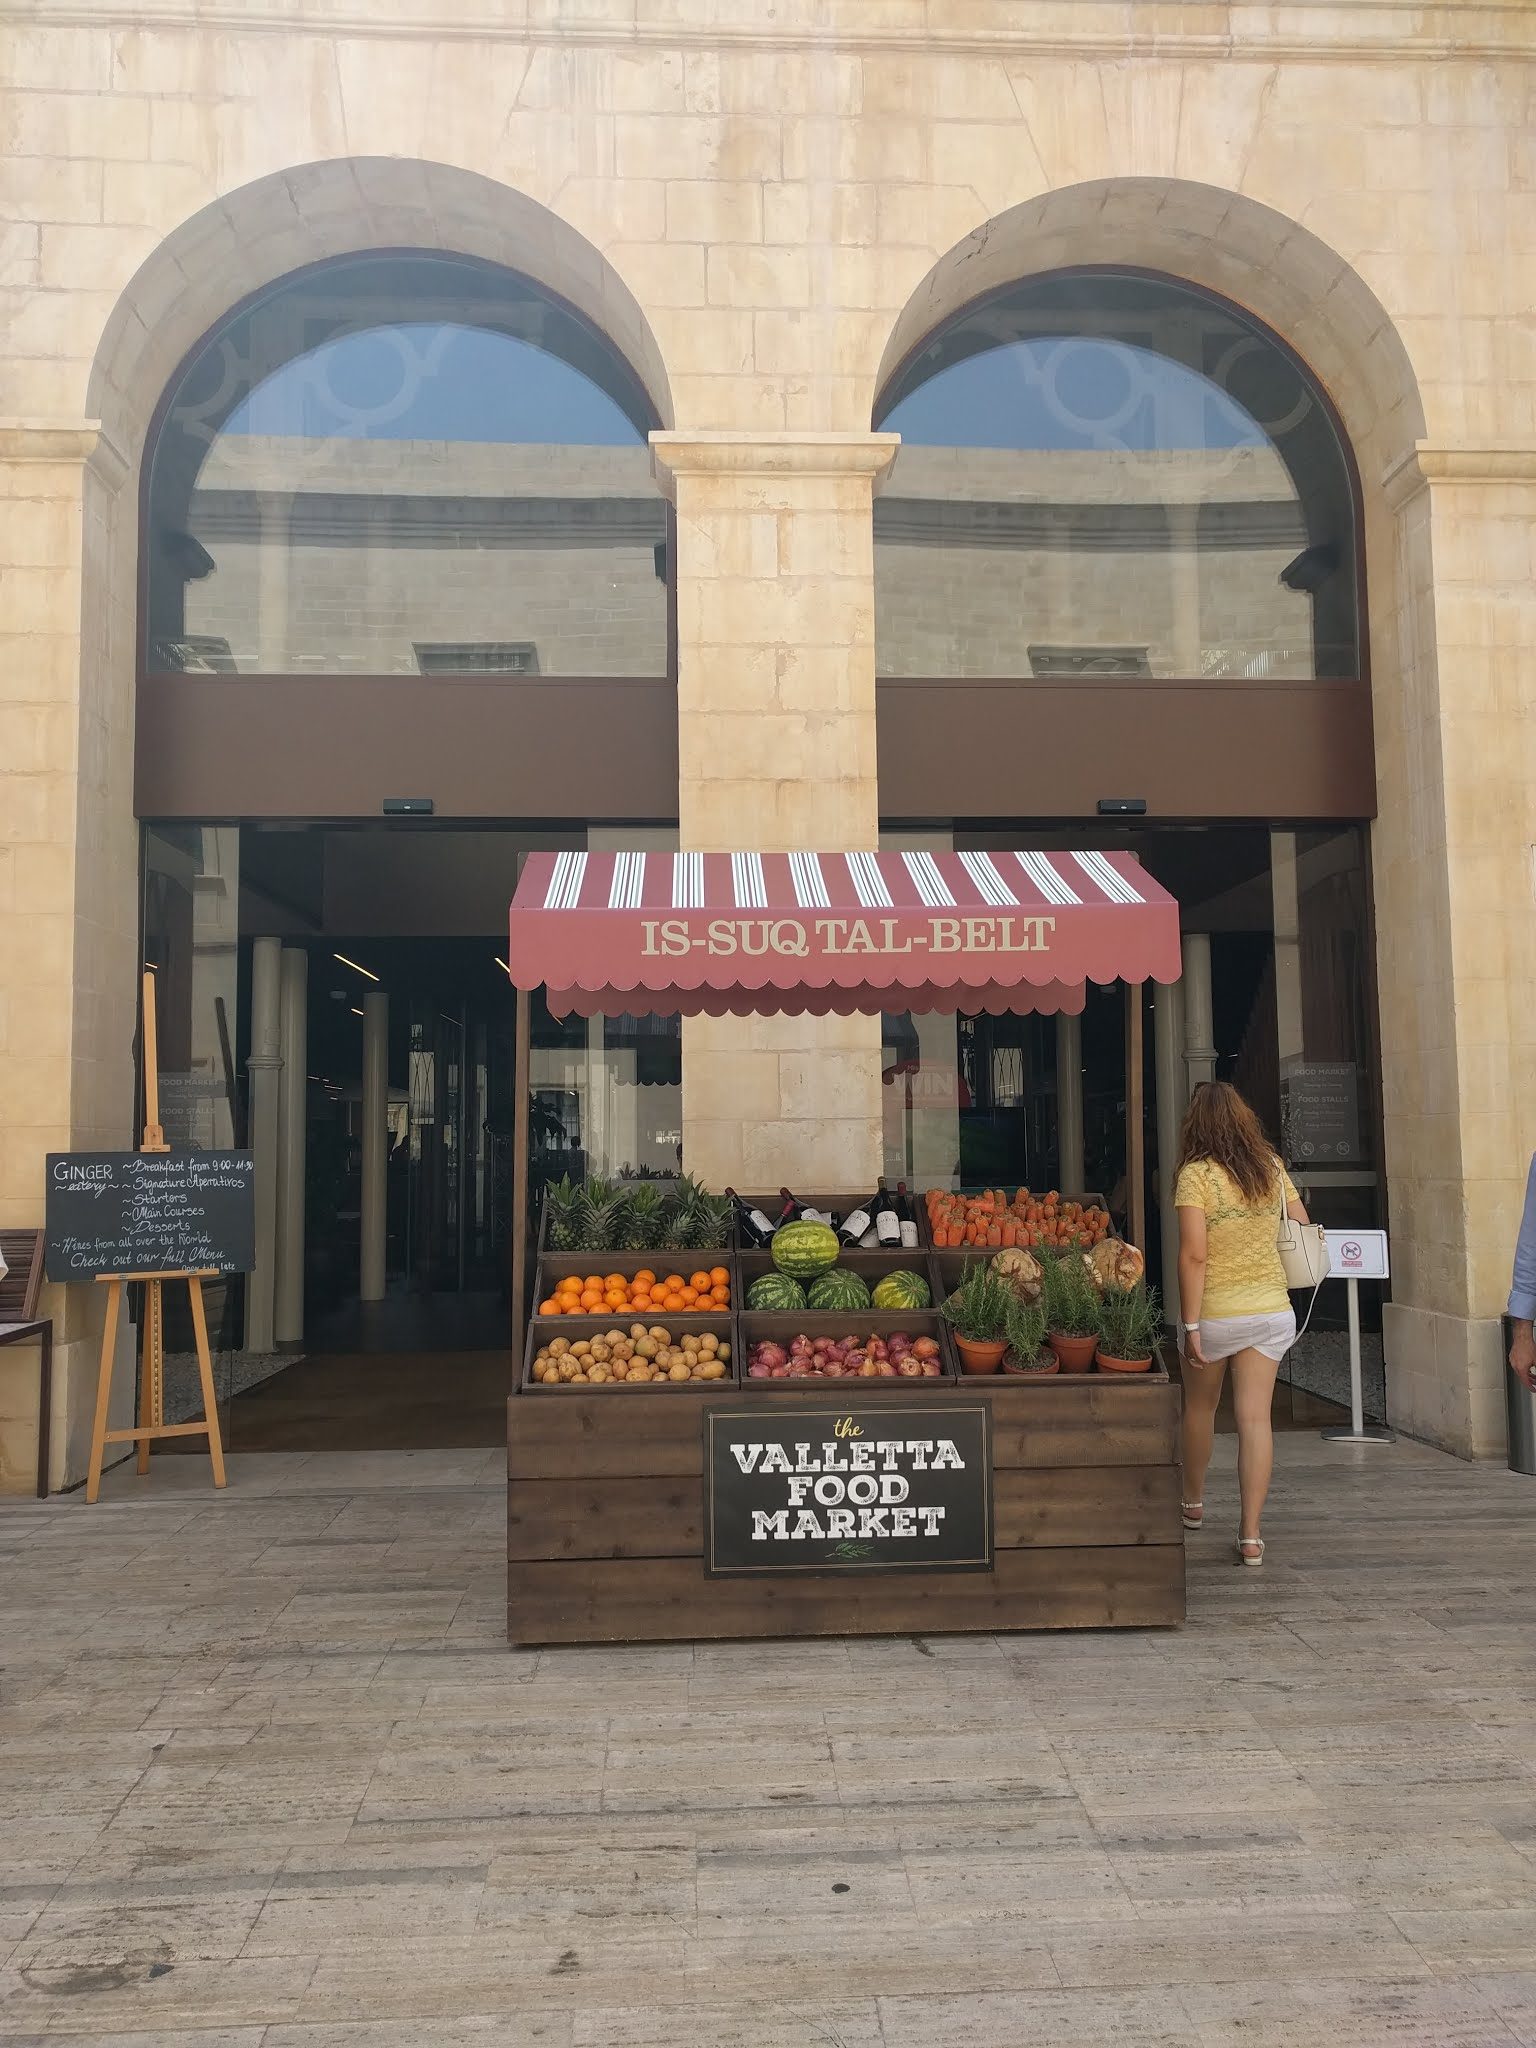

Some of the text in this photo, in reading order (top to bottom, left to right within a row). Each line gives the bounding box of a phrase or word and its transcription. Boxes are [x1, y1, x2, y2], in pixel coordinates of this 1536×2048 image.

[640, 916, 1057, 957] IS-SUQ TAL-BELT
[53, 1162, 113, 1181] GINGER
[130, 1159, 185, 1176] Breakfast
[188, 1158, 210, 1178] from
[133, 1176, 187, 1196] Signature
[132, 1204, 205, 1221] Main Courses
[130, 1219, 190, 1235] Desserts
[94, 1237, 116, 1252] from
[118, 1236, 133, 1248] all
[135, 1238, 156, 1247] over
[159, 1234, 175, 1246] the
[70, 1246, 226, 1270] Check out our full Menu
[833, 1416, 865, 1438] the
[729, 1439, 966, 1474] VALLETTA
[787, 1474, 910, 1506] FOOD
[751, 1506, 946, 1540] MARKET
